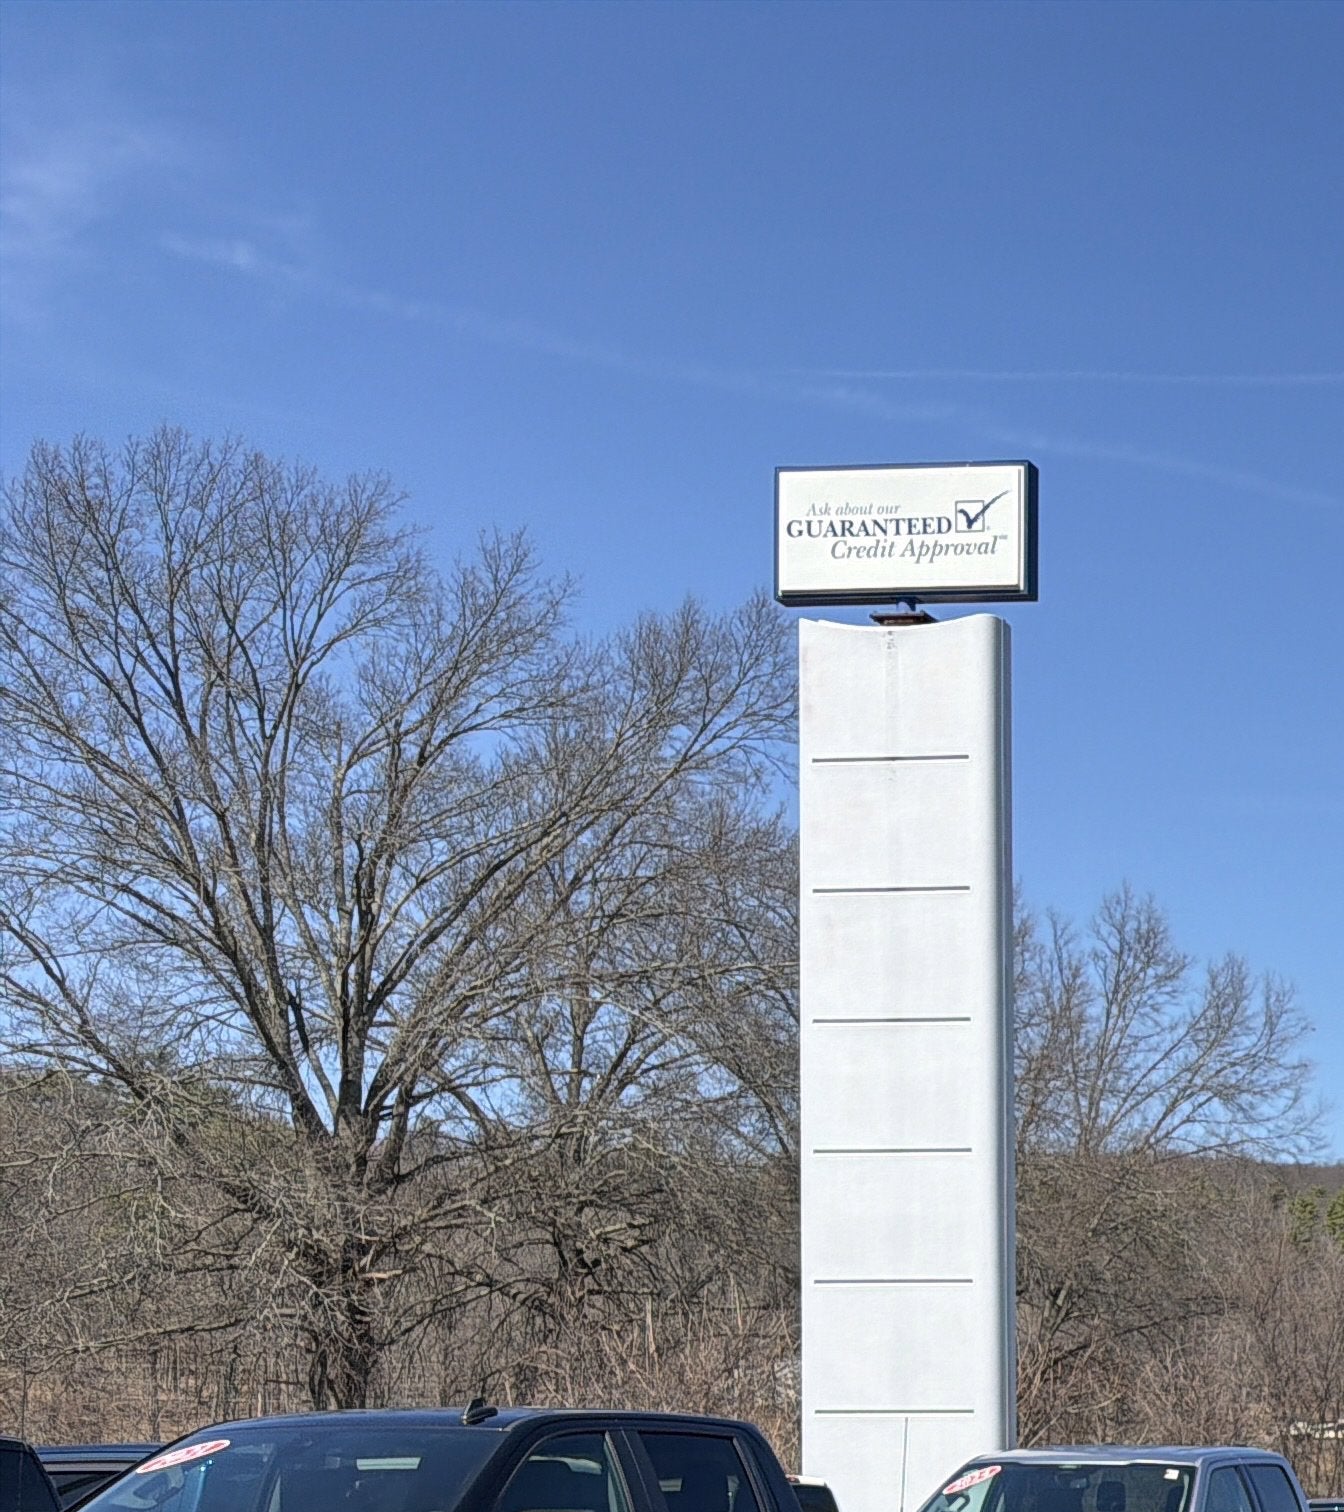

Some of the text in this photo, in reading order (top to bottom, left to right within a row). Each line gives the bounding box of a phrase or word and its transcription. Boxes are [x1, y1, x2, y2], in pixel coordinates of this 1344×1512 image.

[806, 501, 901, 517] Ask about our
[786, 516, 953, 538] GUARANTEED
[830, 535, 998, 564] Credit Approval
